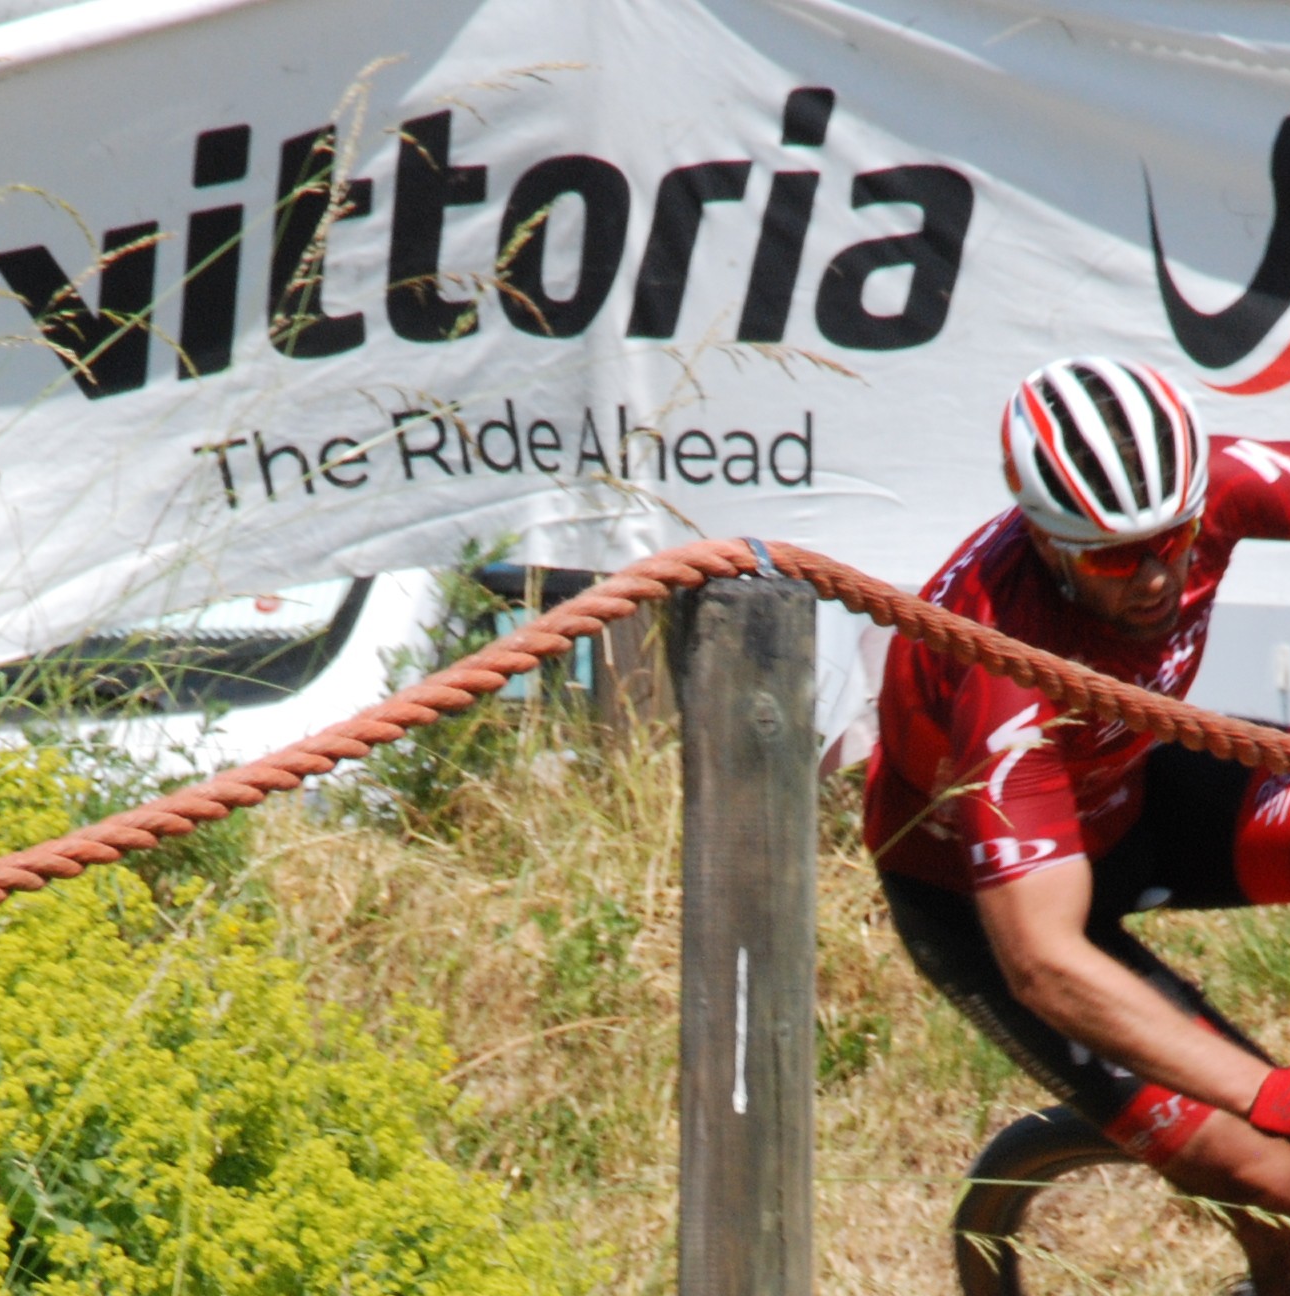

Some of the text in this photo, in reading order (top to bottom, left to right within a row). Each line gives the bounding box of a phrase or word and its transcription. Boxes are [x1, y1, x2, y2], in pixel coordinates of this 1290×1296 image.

[193, 399, 813, 507] The Ride Ahead
